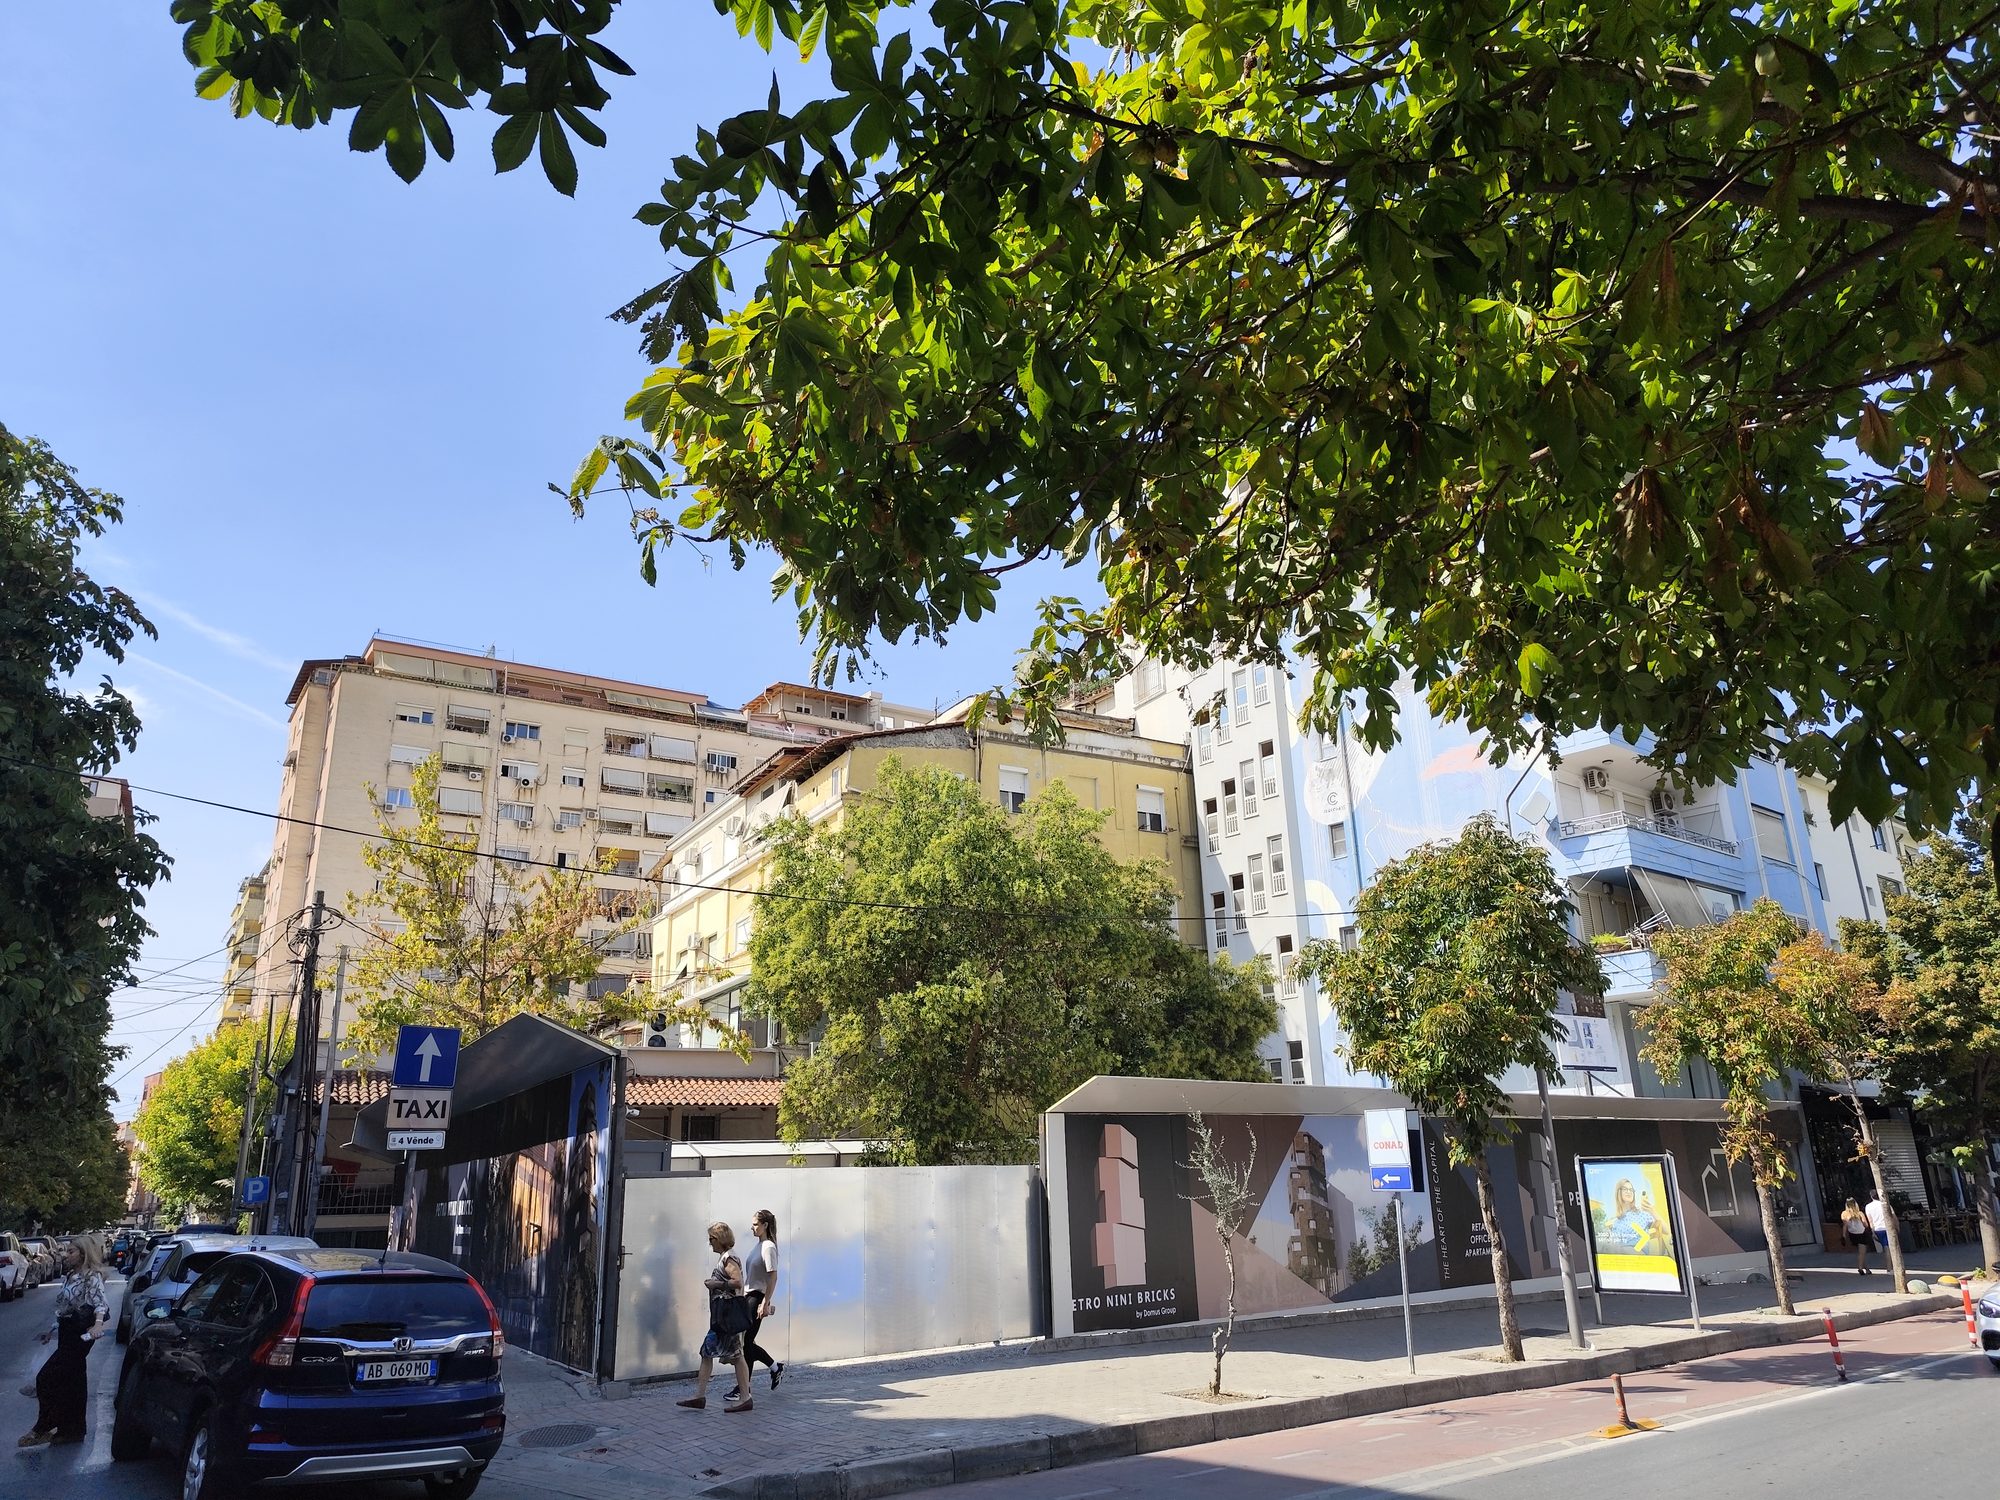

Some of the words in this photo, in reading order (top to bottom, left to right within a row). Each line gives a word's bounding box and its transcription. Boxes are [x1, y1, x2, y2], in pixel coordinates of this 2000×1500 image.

[393, 1099, 447, 1119] TAXI
[398, 1137, 404, 1145] 4
[1373, 1141, 1404, 1150] CONAD
[1429, 1140, 1440, 1184] CAPITAL
[247, 1180, 264, 1201] P
[1569, 1191, 1581, 1207] PE
[1437, 1207, 1444, 1222] OF
[1471, 1222, 1486, 1232] RETA
[1439, 1225, 1448, 1258] HEART
[1464, 1248, 1492, 1258] APARTAM
[1072, 1296, 1101, 1311] ETRO
[1106, 1293, 1133, 1308] NINI
[1137, 1288, 1176, 1304] BRICKS
[1136, 1311, 1143, 1319] by
[1143, 1308, 1160, 1317] Domus
[1161, 1307, 1176, 1316] Group
[368, 1364, 383, 1378] AB
